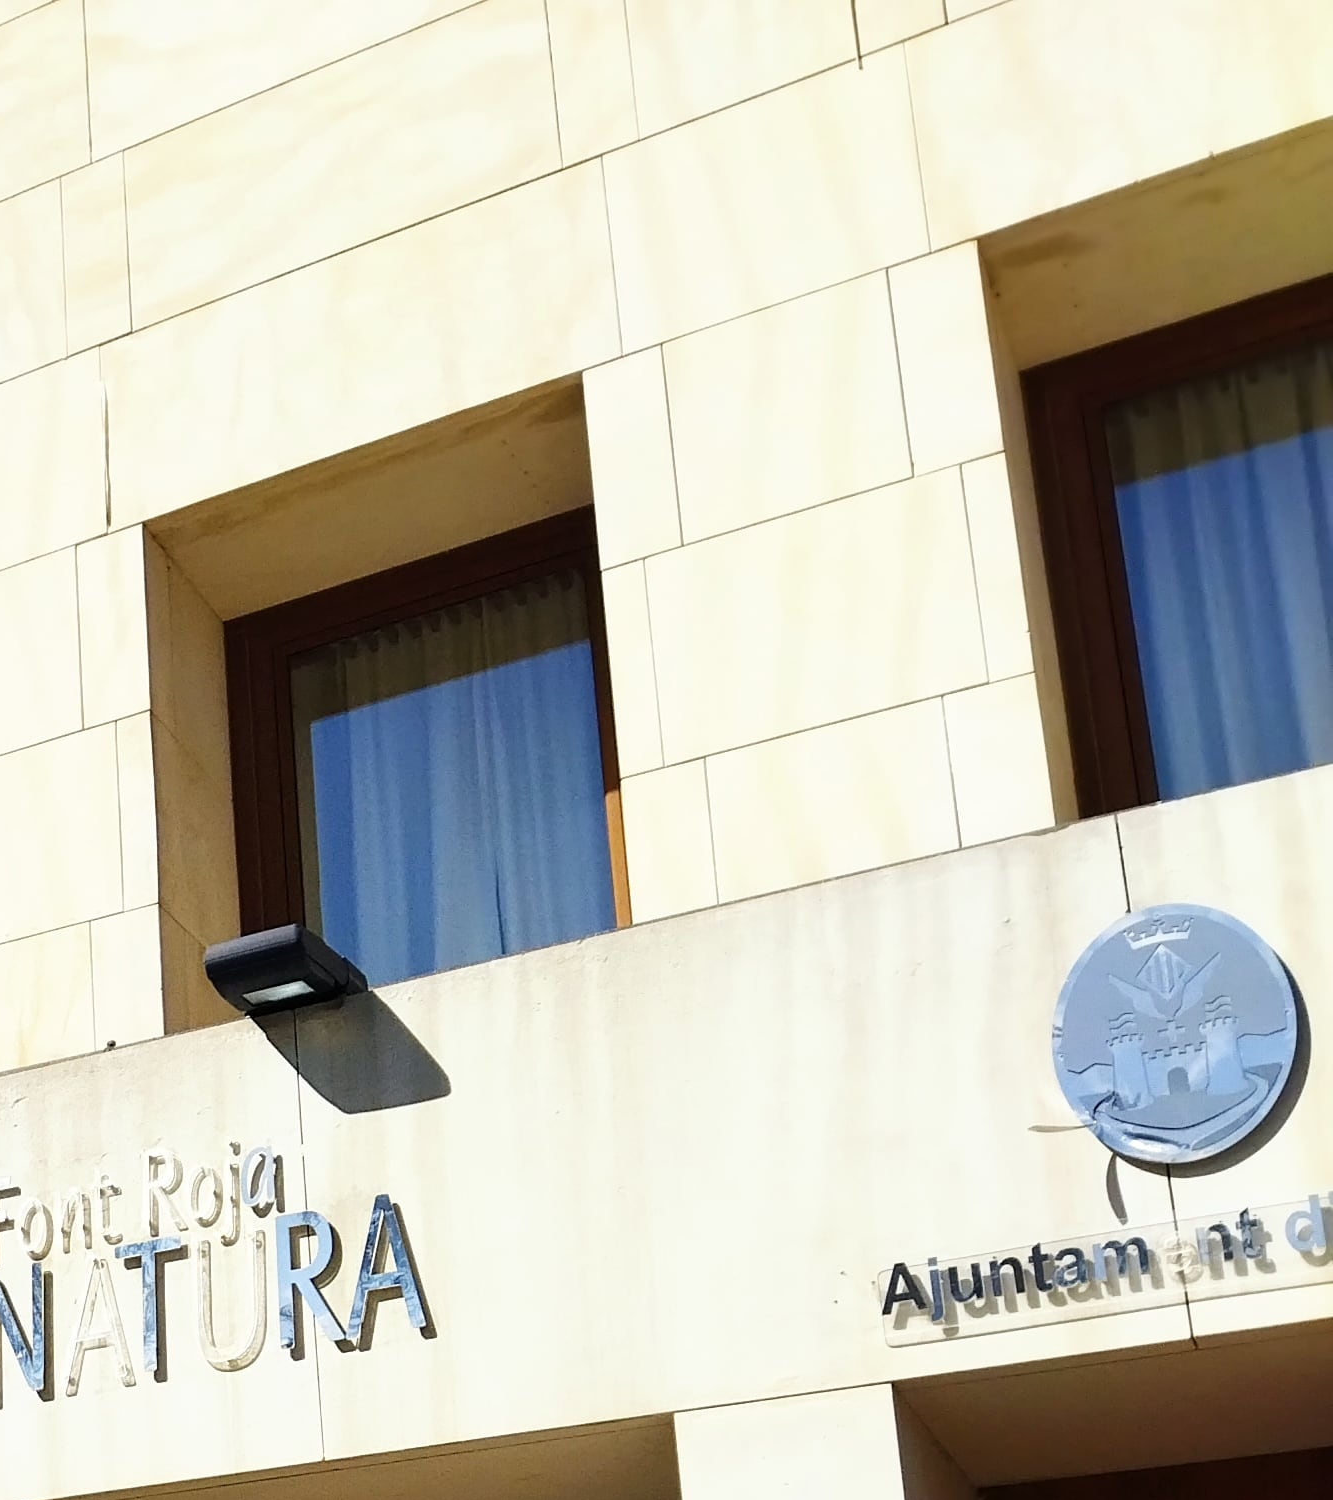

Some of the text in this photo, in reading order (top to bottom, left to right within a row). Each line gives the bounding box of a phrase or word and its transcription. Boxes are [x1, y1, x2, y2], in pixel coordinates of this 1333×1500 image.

[143, 1140, 286, 1247] Roja
[881, 1193, 1333, 1326] Ajuntament d
